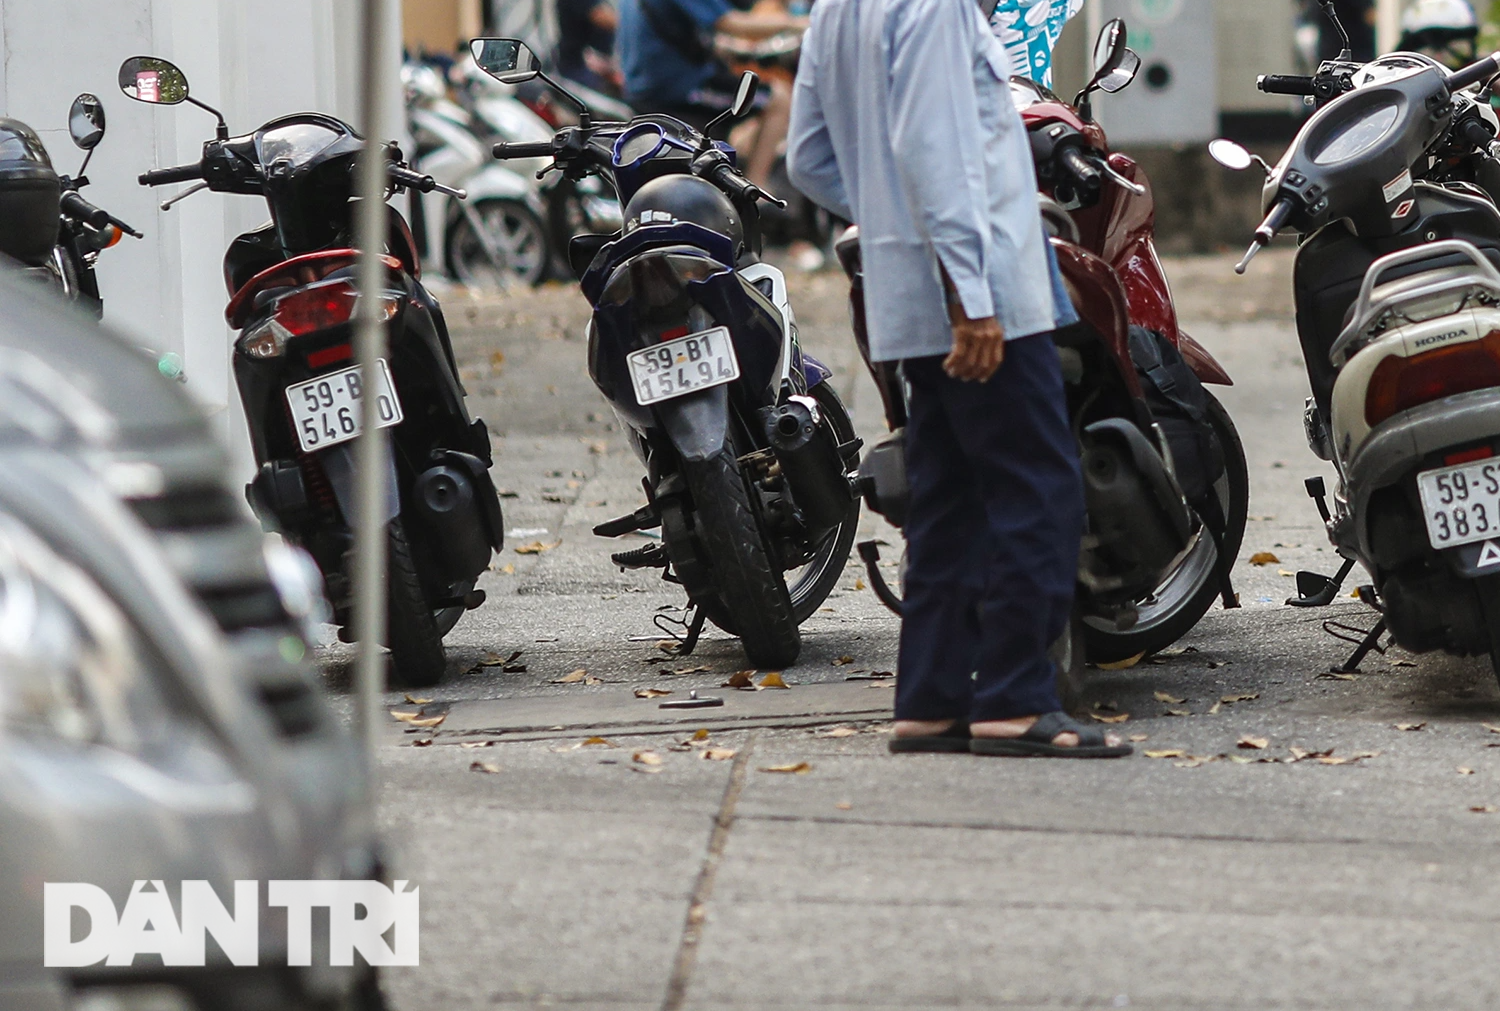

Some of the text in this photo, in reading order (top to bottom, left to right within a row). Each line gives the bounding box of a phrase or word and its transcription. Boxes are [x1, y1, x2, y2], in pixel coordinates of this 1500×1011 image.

[643, 335, 713, 375] 59-B1
[1414, 328, 1469, 348] HONDA
[302, 372, 365, 412] 59-B
[640, 356, 732, 400] 154.94
[301, 394, 394, 445] 5460
